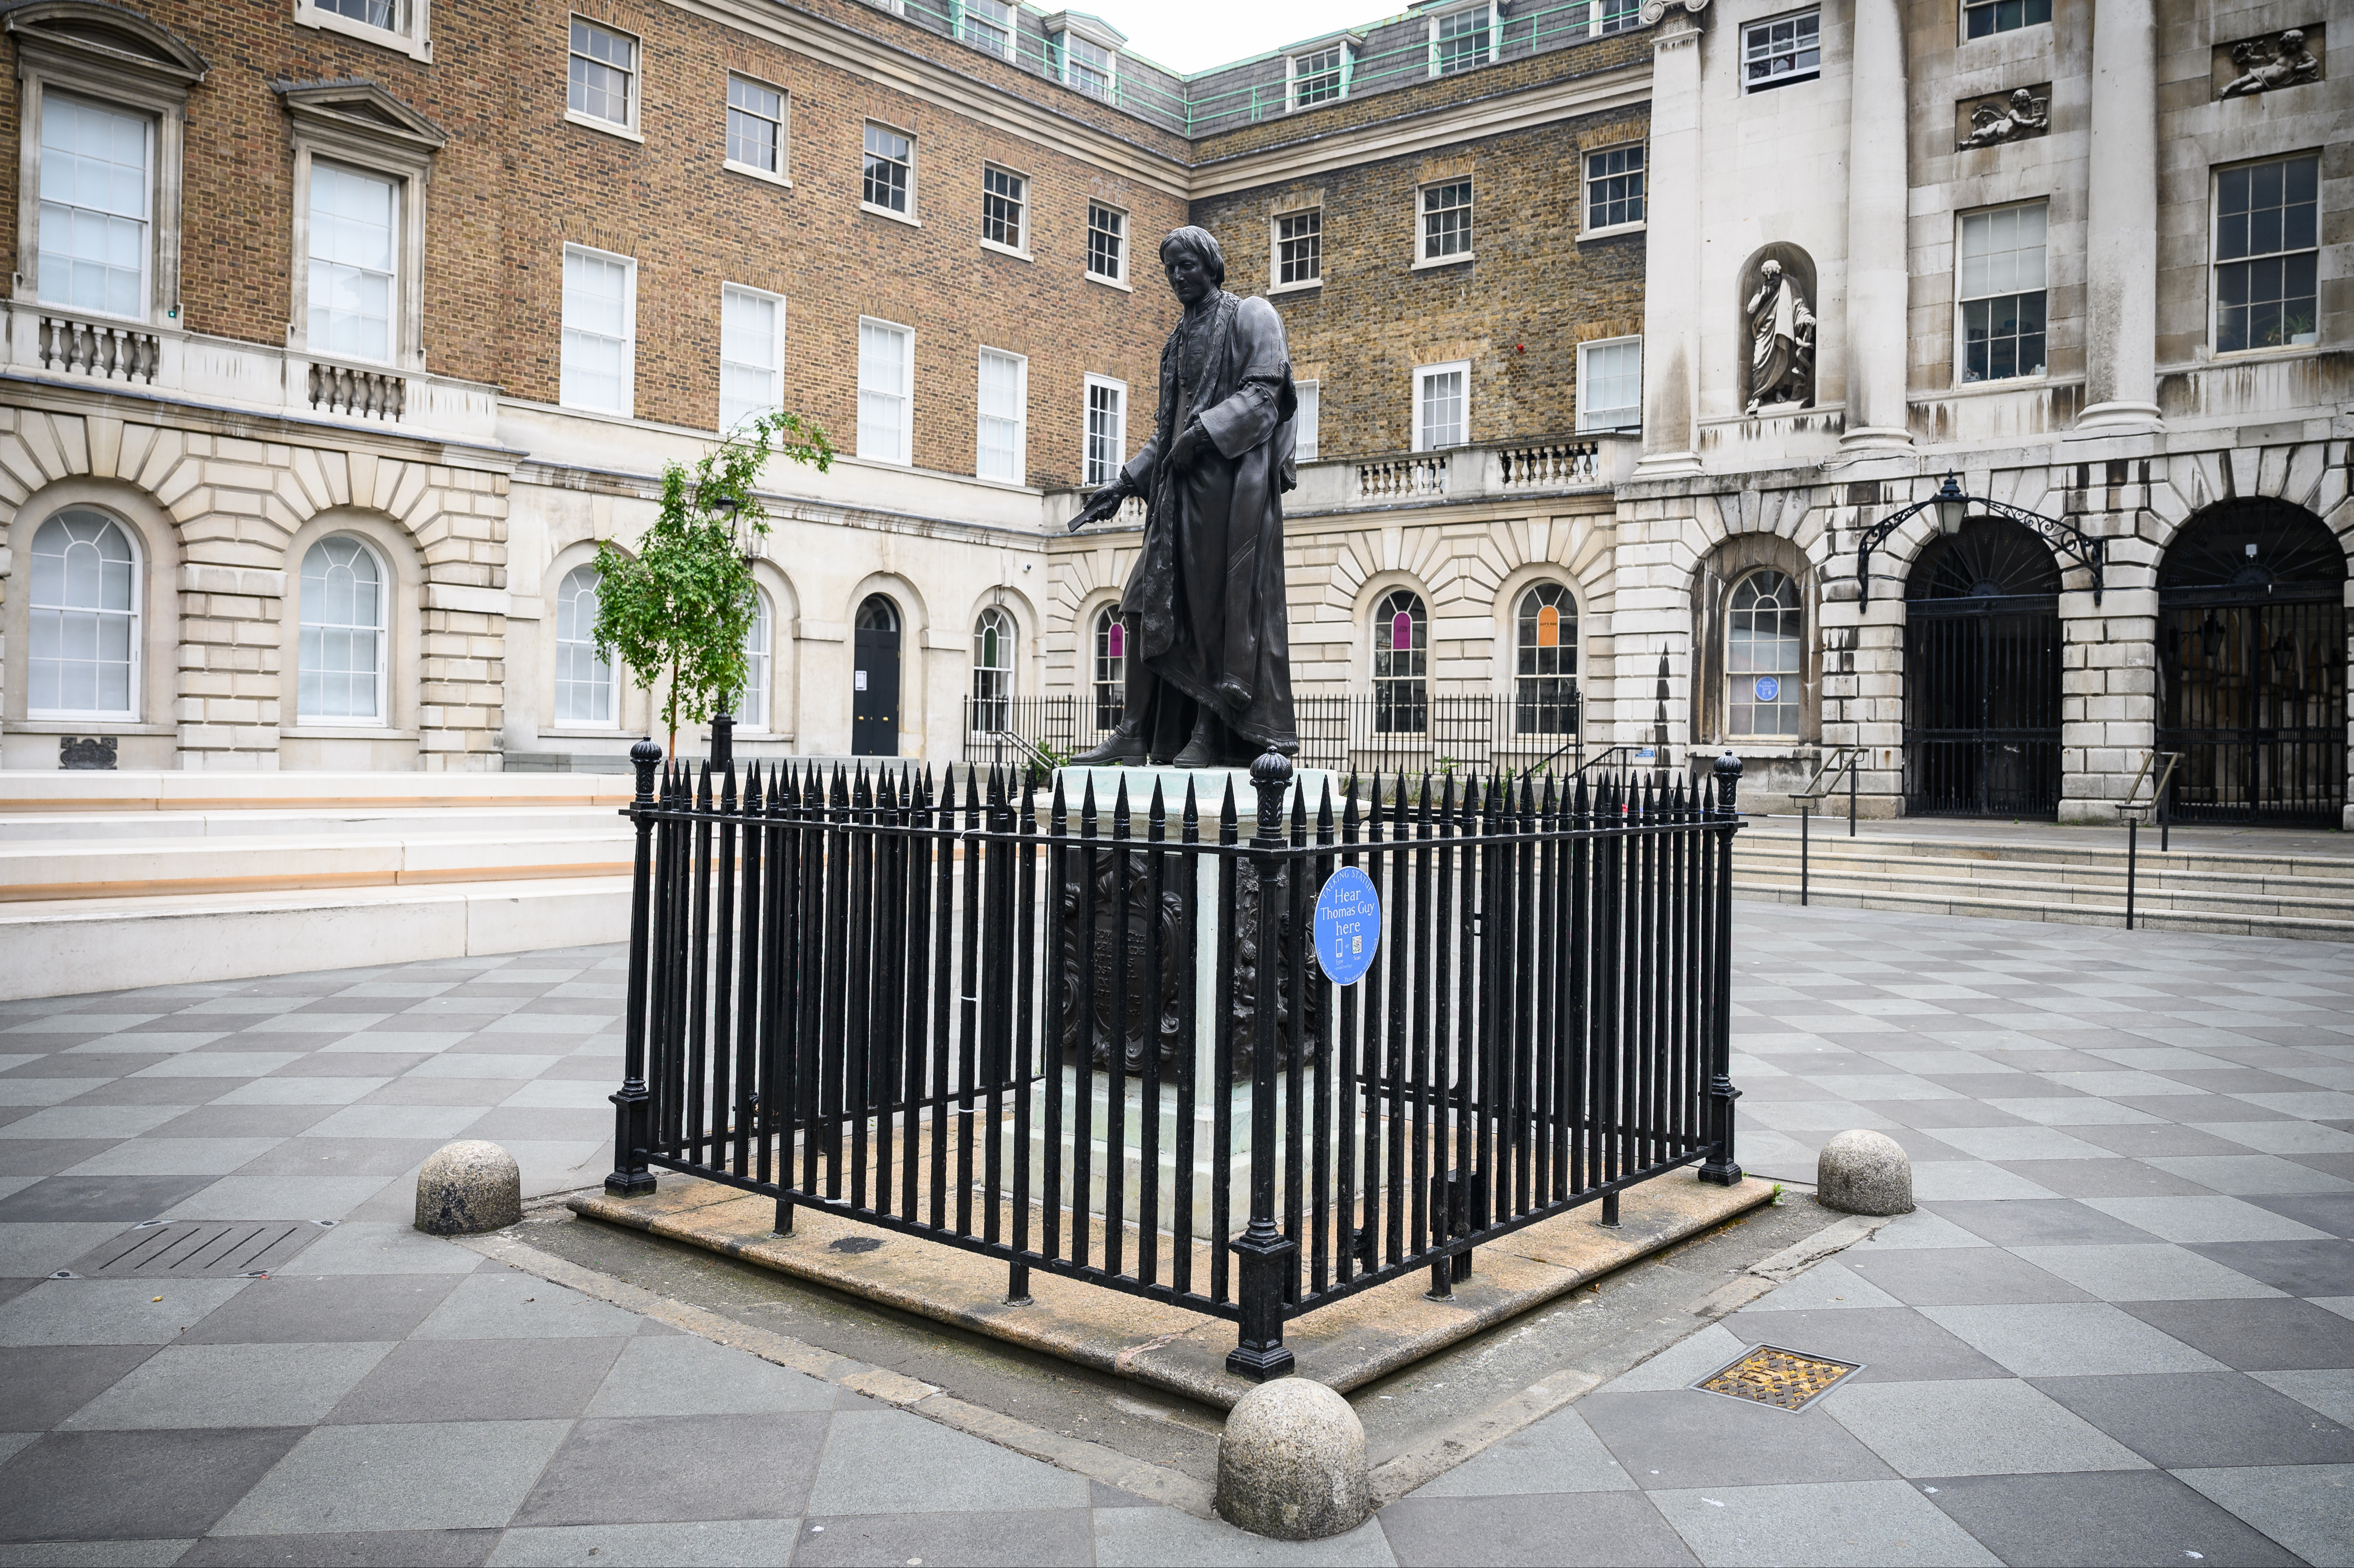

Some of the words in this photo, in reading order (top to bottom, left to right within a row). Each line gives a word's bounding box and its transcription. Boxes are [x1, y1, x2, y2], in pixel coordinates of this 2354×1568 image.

[1322, 870, 1349, 899] TALKING
[1351, 869, 1373, 894] STATUE
[1335, 888, 1361, 904] Hear
[1320, 906, 1355, 920] Thomas
[1358, 901, 1375, 916] Guy
[1336, 921, 1360, 936] here
[1320, 960, 1329, 971] your
[1327, 970, 1338, 981] phone
[1352, 970, 1362, 980] statue
